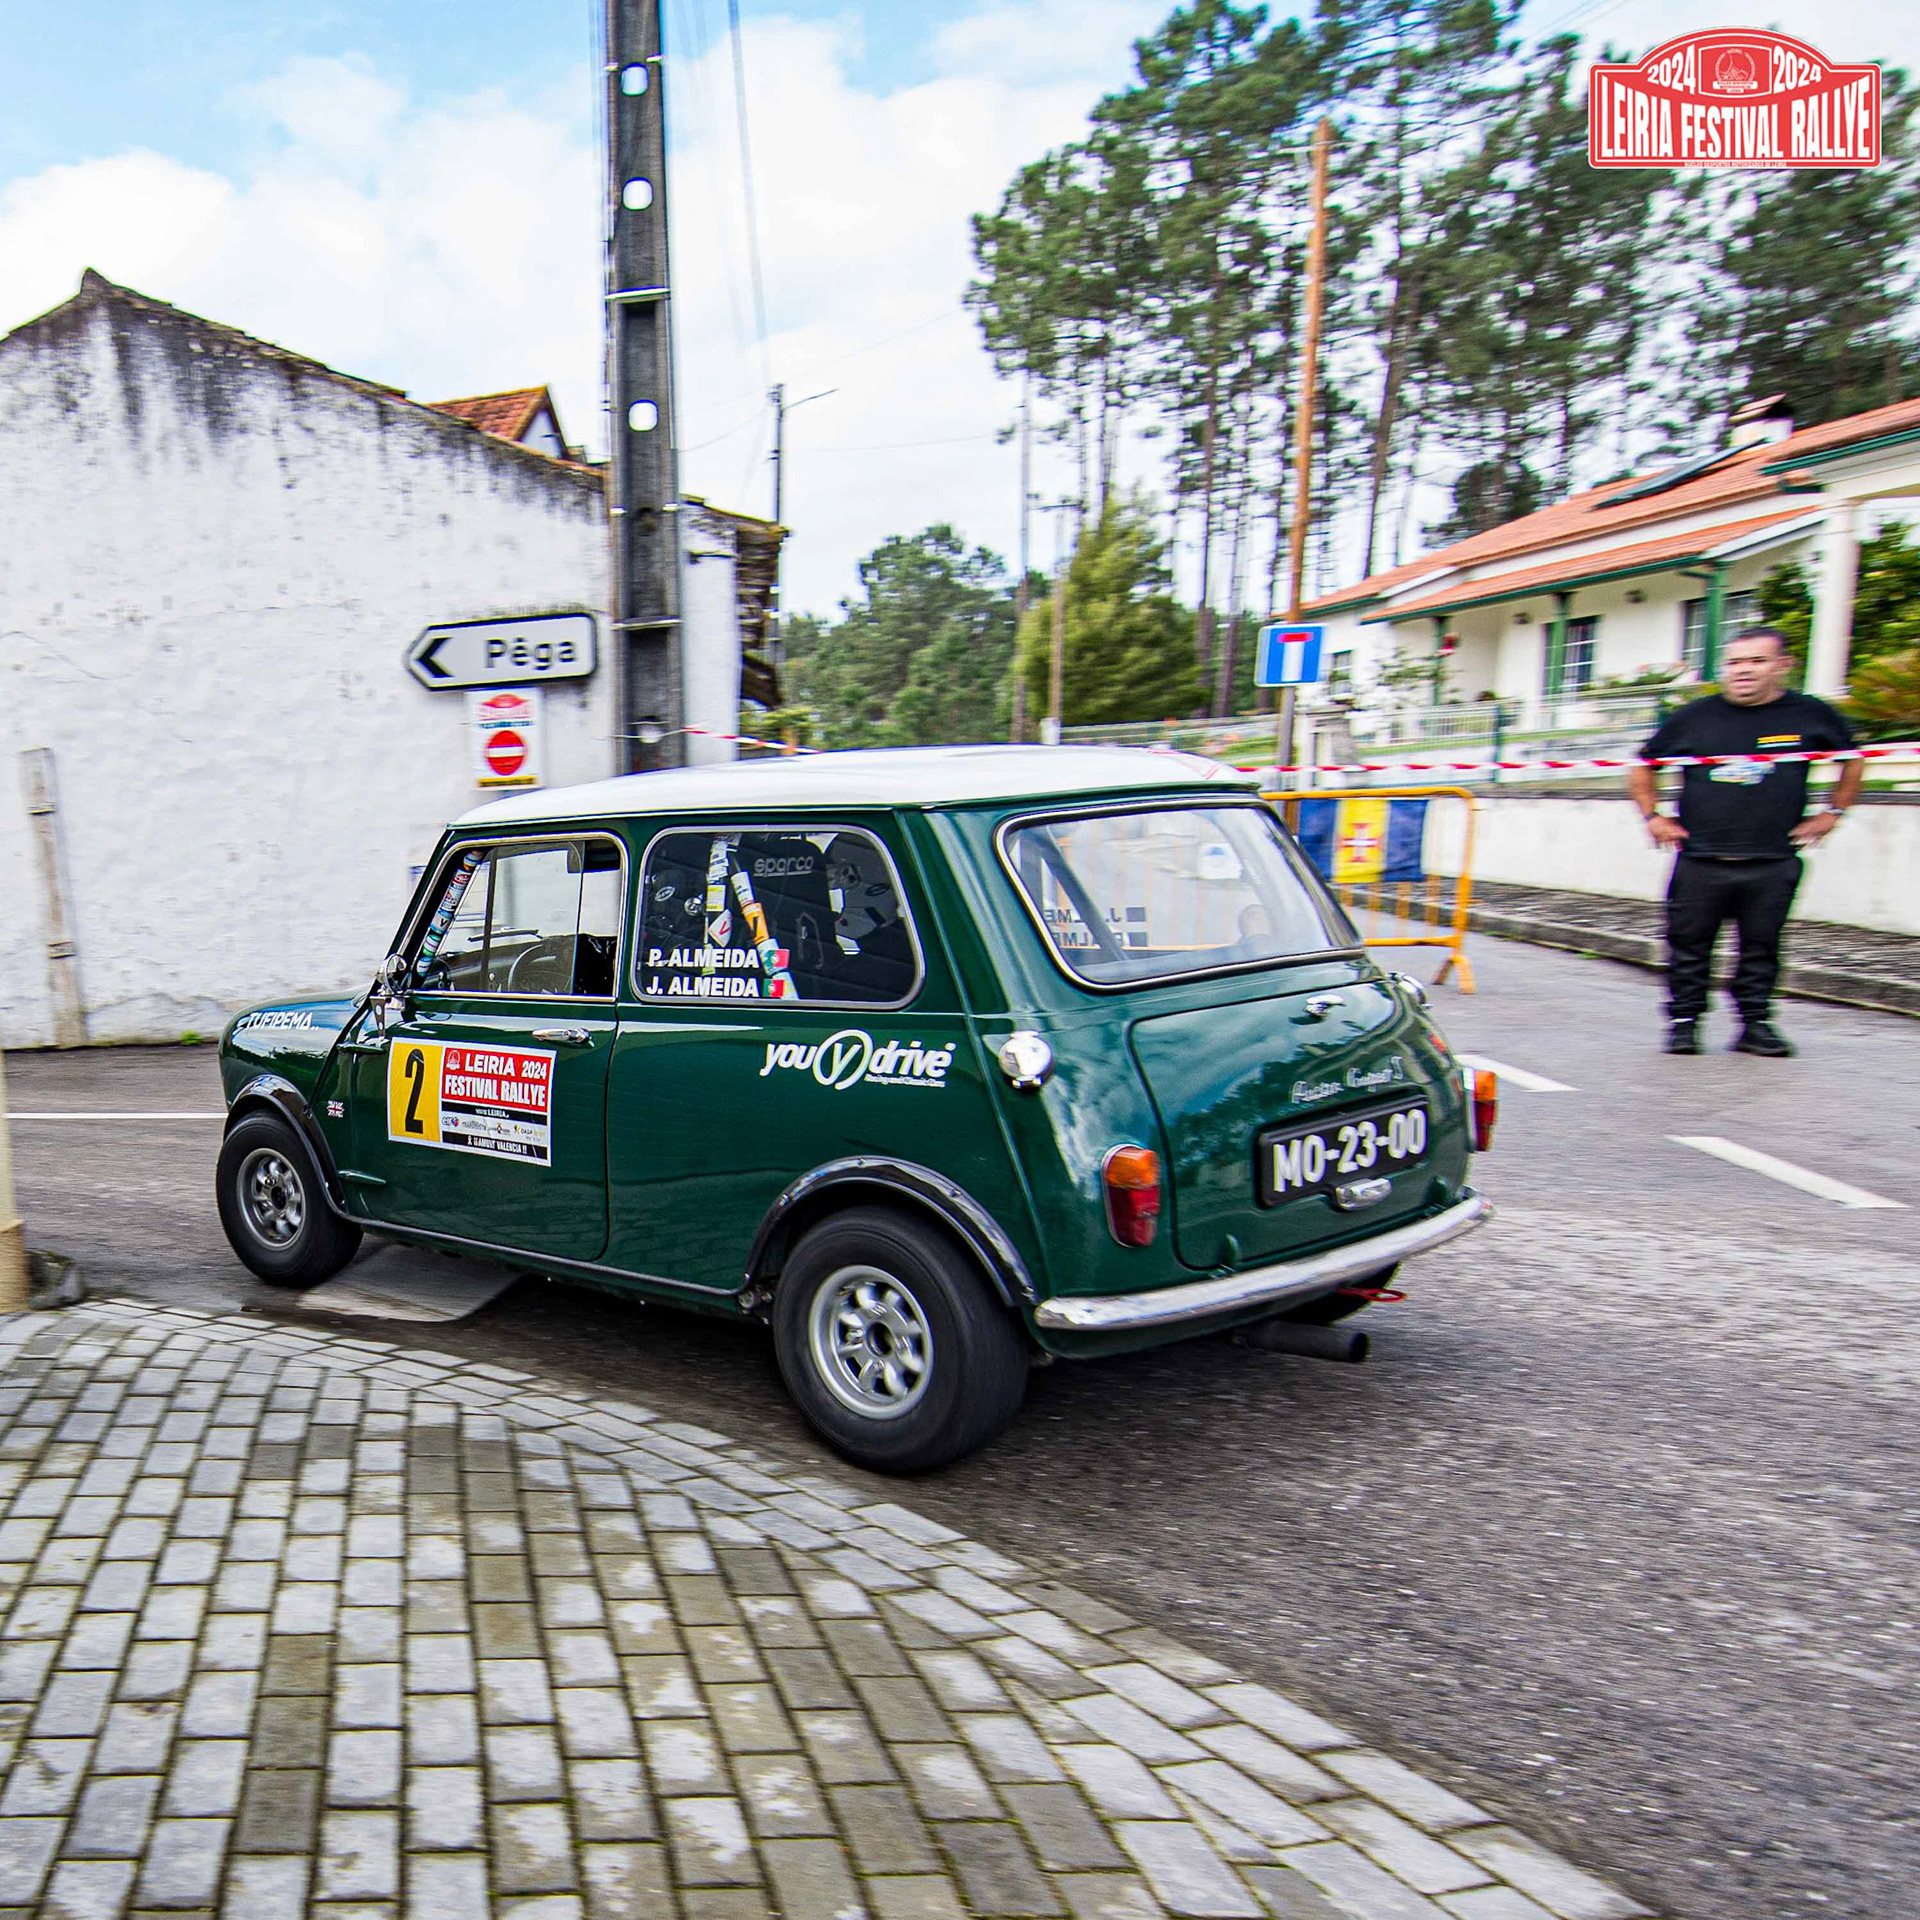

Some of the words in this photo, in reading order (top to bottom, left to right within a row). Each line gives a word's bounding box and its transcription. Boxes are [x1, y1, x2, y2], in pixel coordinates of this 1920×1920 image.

[484, 636, 576, 671] Pêga
[753, 855, 814, 877] sparco
[649, 949, 665, 967] P.
[668, 949, 759, 968] ALMEIDA
[646, 977, 663, 995] J.
[671, 977, 759, 997] ALMEIDA
[465, 1053, 515, 1076] LEIRIA
[521, 1060, 547, 1080] 2024
[759, 1043, 817, 1076] you
[405, 1049, 425, 1134] 2
[445, 1075, 499, 1100] FESTIVAL
[501, 1080, 546, 1107] RALLYE
[1273, 1109, 1426, 1192] MO-23-00
